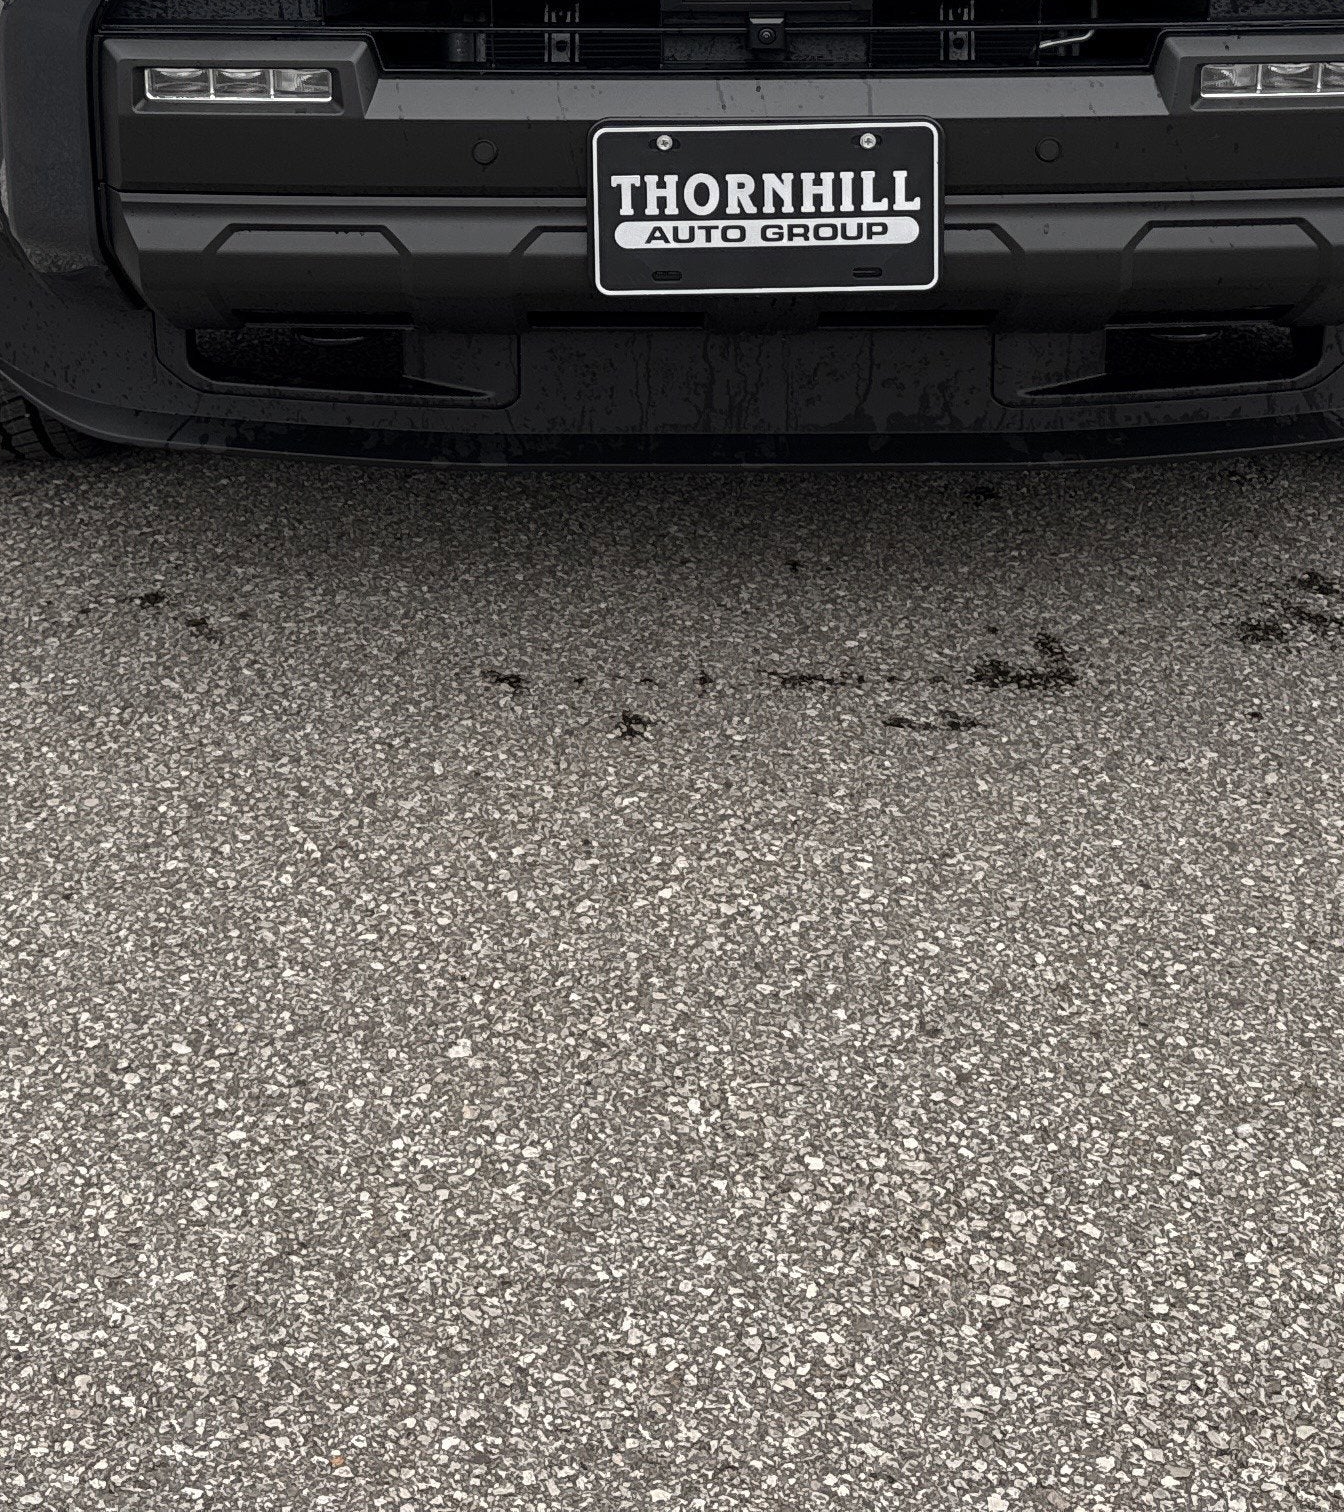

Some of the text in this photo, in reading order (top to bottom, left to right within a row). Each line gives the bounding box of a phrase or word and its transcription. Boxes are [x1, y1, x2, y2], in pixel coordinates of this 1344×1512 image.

[611, 170, 921, 216] THORNHILL
[645, 221, 889, 245] AUTO GROUP
